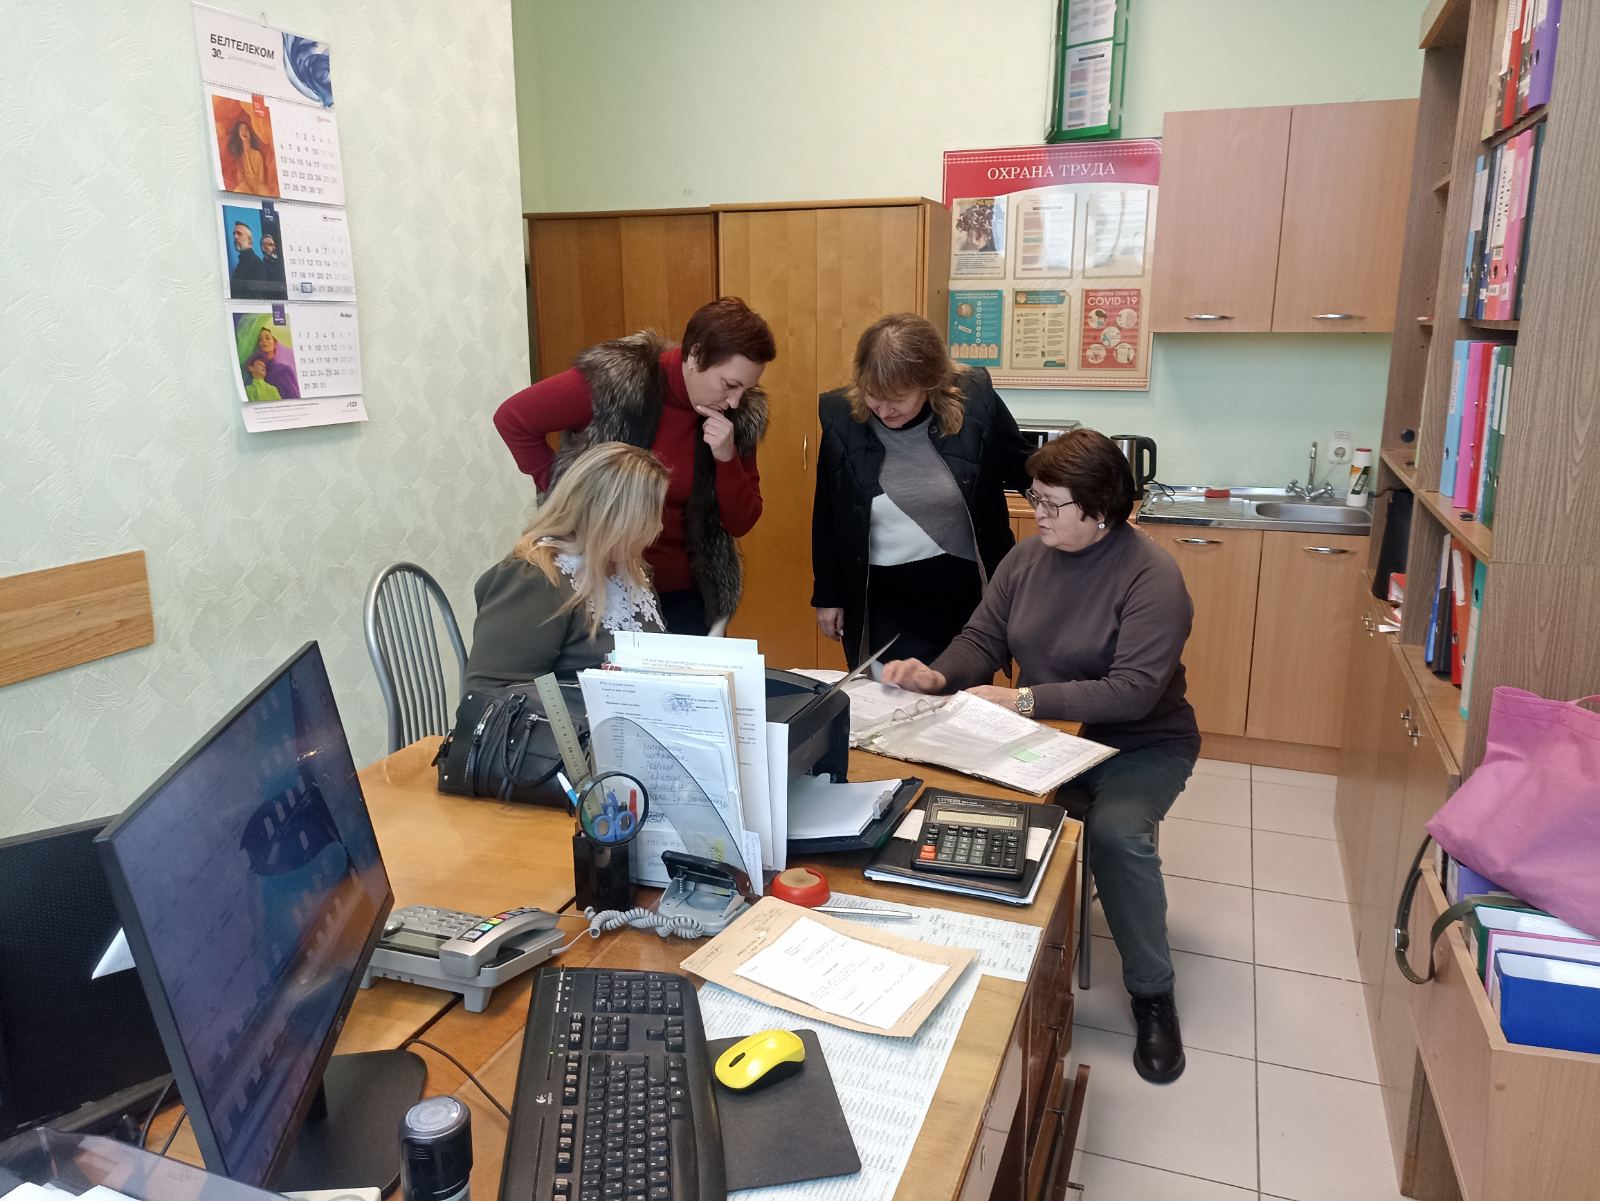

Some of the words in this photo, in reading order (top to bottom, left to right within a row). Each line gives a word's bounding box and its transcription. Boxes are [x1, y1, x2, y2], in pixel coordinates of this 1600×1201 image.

[210, 34, 275, 60] БЕЛТЕЛЕКОМ
[987, 165, 1054, 180] ОХРАНА
[1059, 162, 1115, 177] ТРУДА
[1088, 296, 1138, 305] COVID-19
